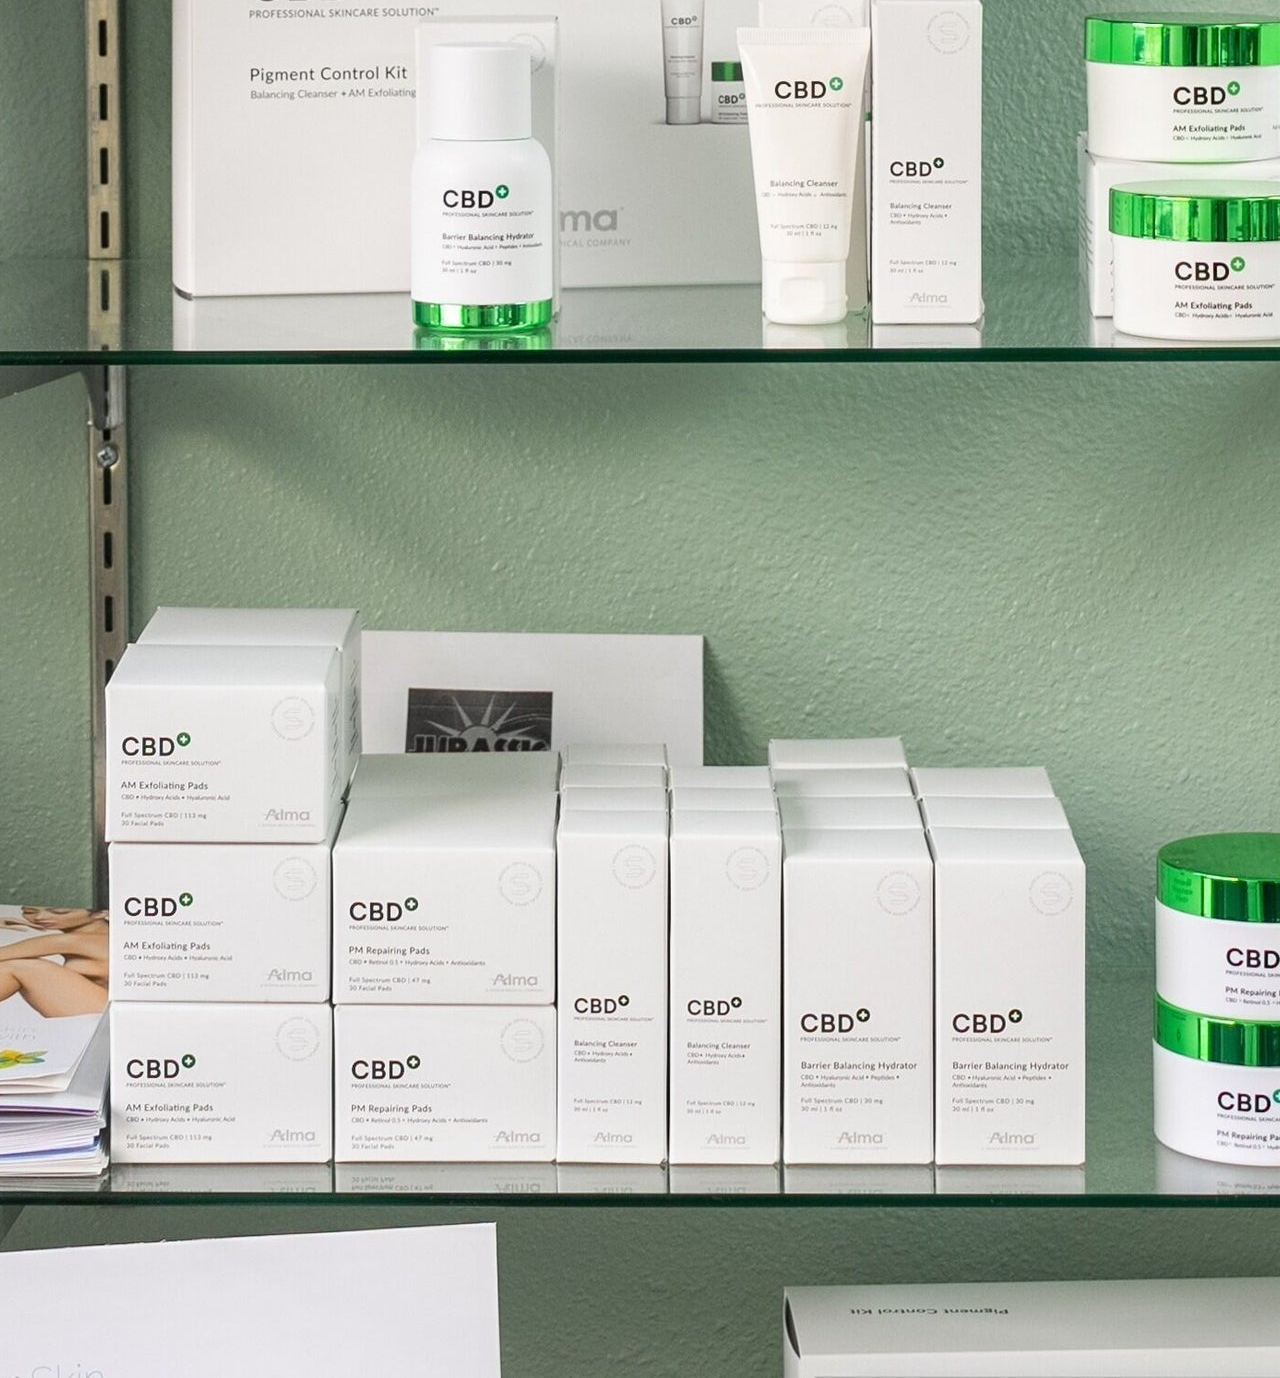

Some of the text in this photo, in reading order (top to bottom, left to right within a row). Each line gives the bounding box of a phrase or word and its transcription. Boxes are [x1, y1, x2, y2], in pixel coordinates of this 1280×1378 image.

[250, 65, 408, 84] Pigment Control Kit
[775, 81, 827, 99] CBD
[1173, 87, 1227, 105] CBD
[890, 161, 932, 177] CBD
[443, 190, 494, 210] CBD
[1174, 262, 1230, 282] CBD
[122, 738, 175, 757] CBD
[121, 780, 208, 791] AM Exfoliating Pads
[124, 898, 177, 917] CBD
[350, 902, 403, 921] CBD
[349, 946, 429, 956] PM Repairing Pads
[1226, 948, 1280, 968] CBD
[801, 1014, 854, 1033] CBD
[801, 1061, 917, 1072] Barrier Balancing Hydrator
